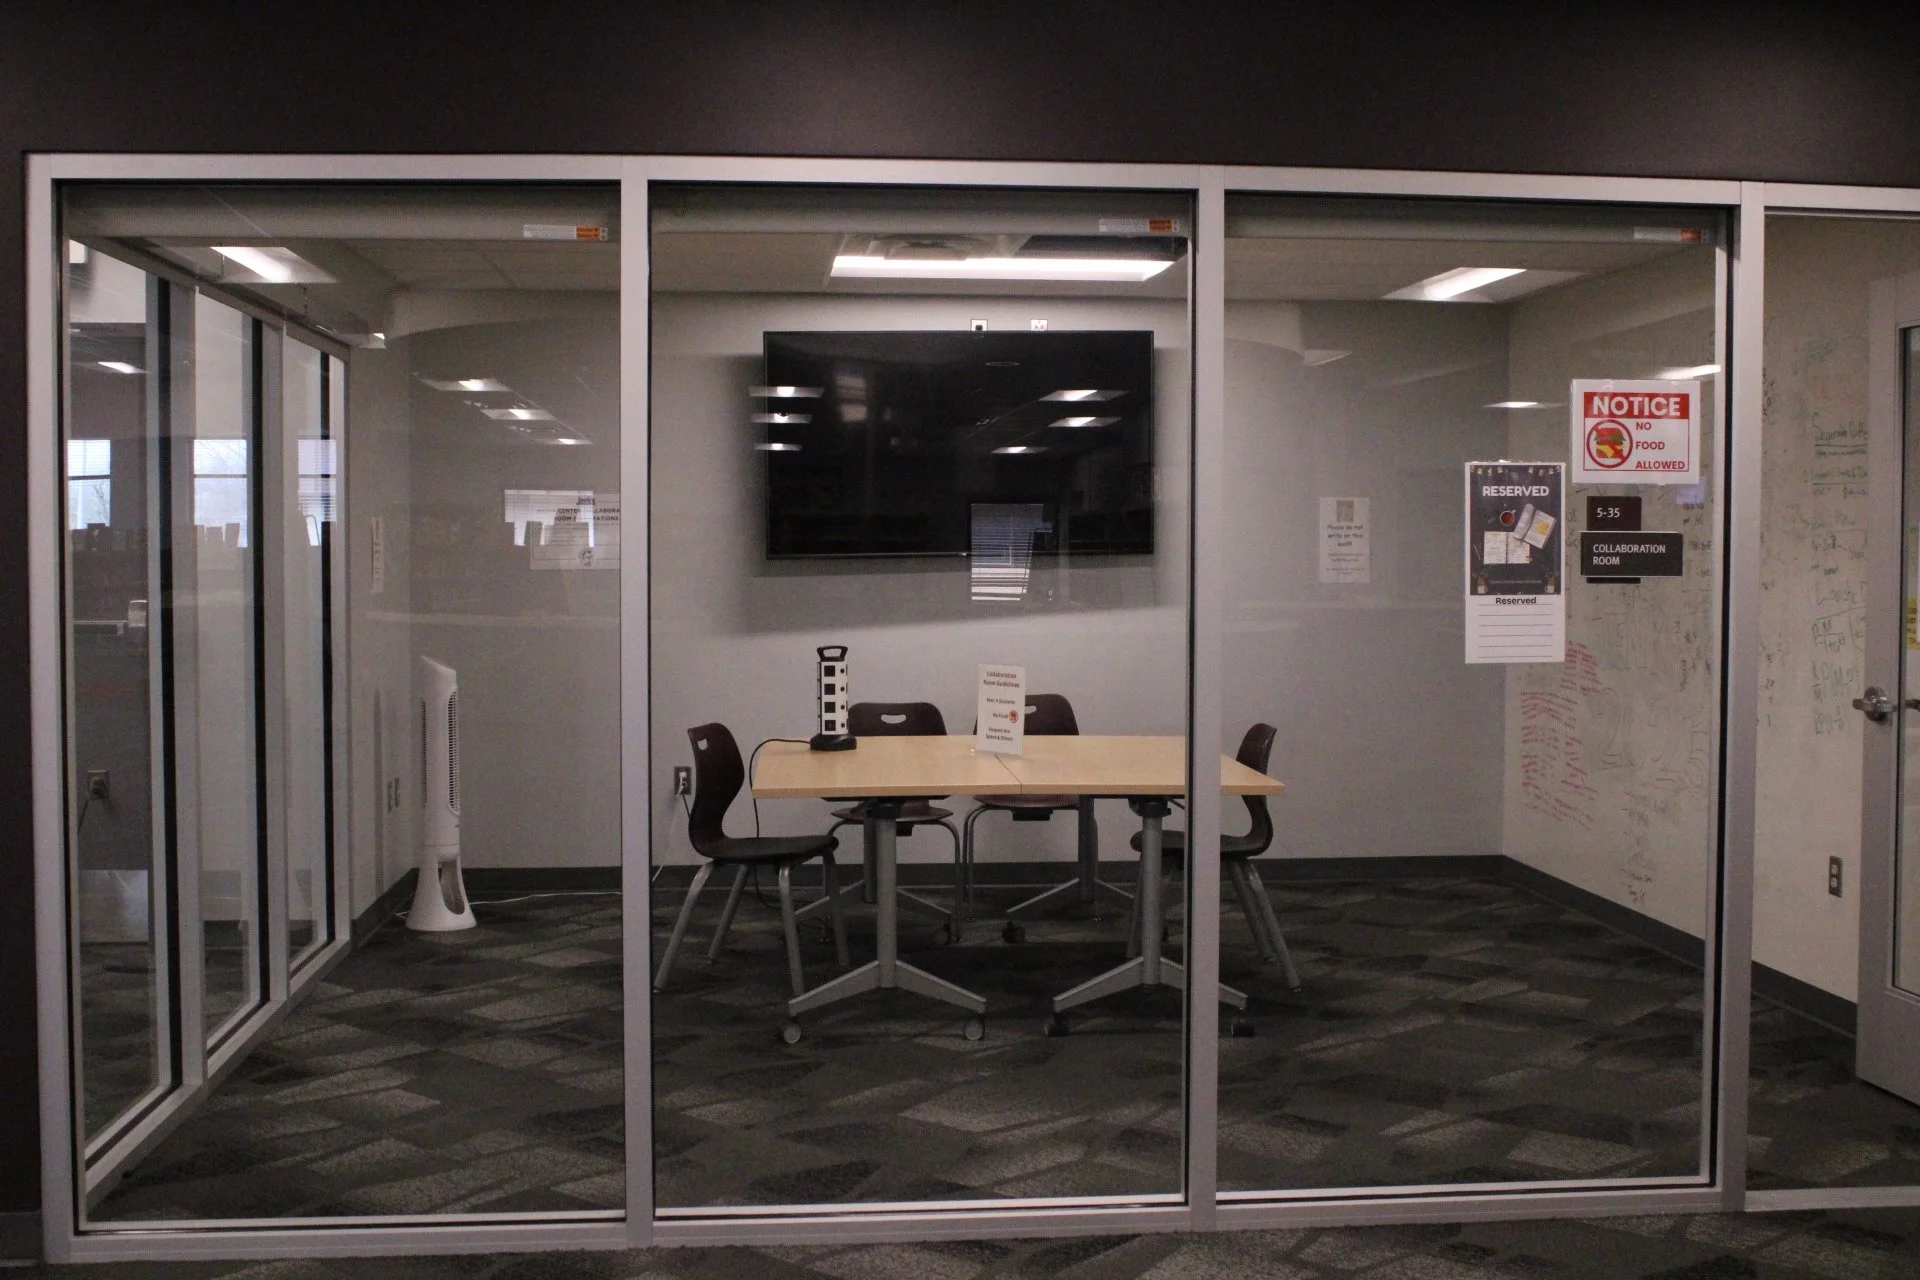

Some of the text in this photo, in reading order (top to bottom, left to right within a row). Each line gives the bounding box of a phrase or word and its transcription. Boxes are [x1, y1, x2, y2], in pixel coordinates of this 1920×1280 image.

[1592, 396, 1681, 416] NOTICE
[1635, 422, 1652, 431] NO
[1635, 441, 1666, 450] FOOD
[1635, 460, 1686, 470] ALLOWED
[1482, 485, 1550, 497] RESERVED
[1596, 507, 1621, 518] 5-35
[1593, 544, 1666, 554] COLLABORATION
[1593, 556, 1620, 566] ROOM
[1495, 596, 1537, 605] Reserved
